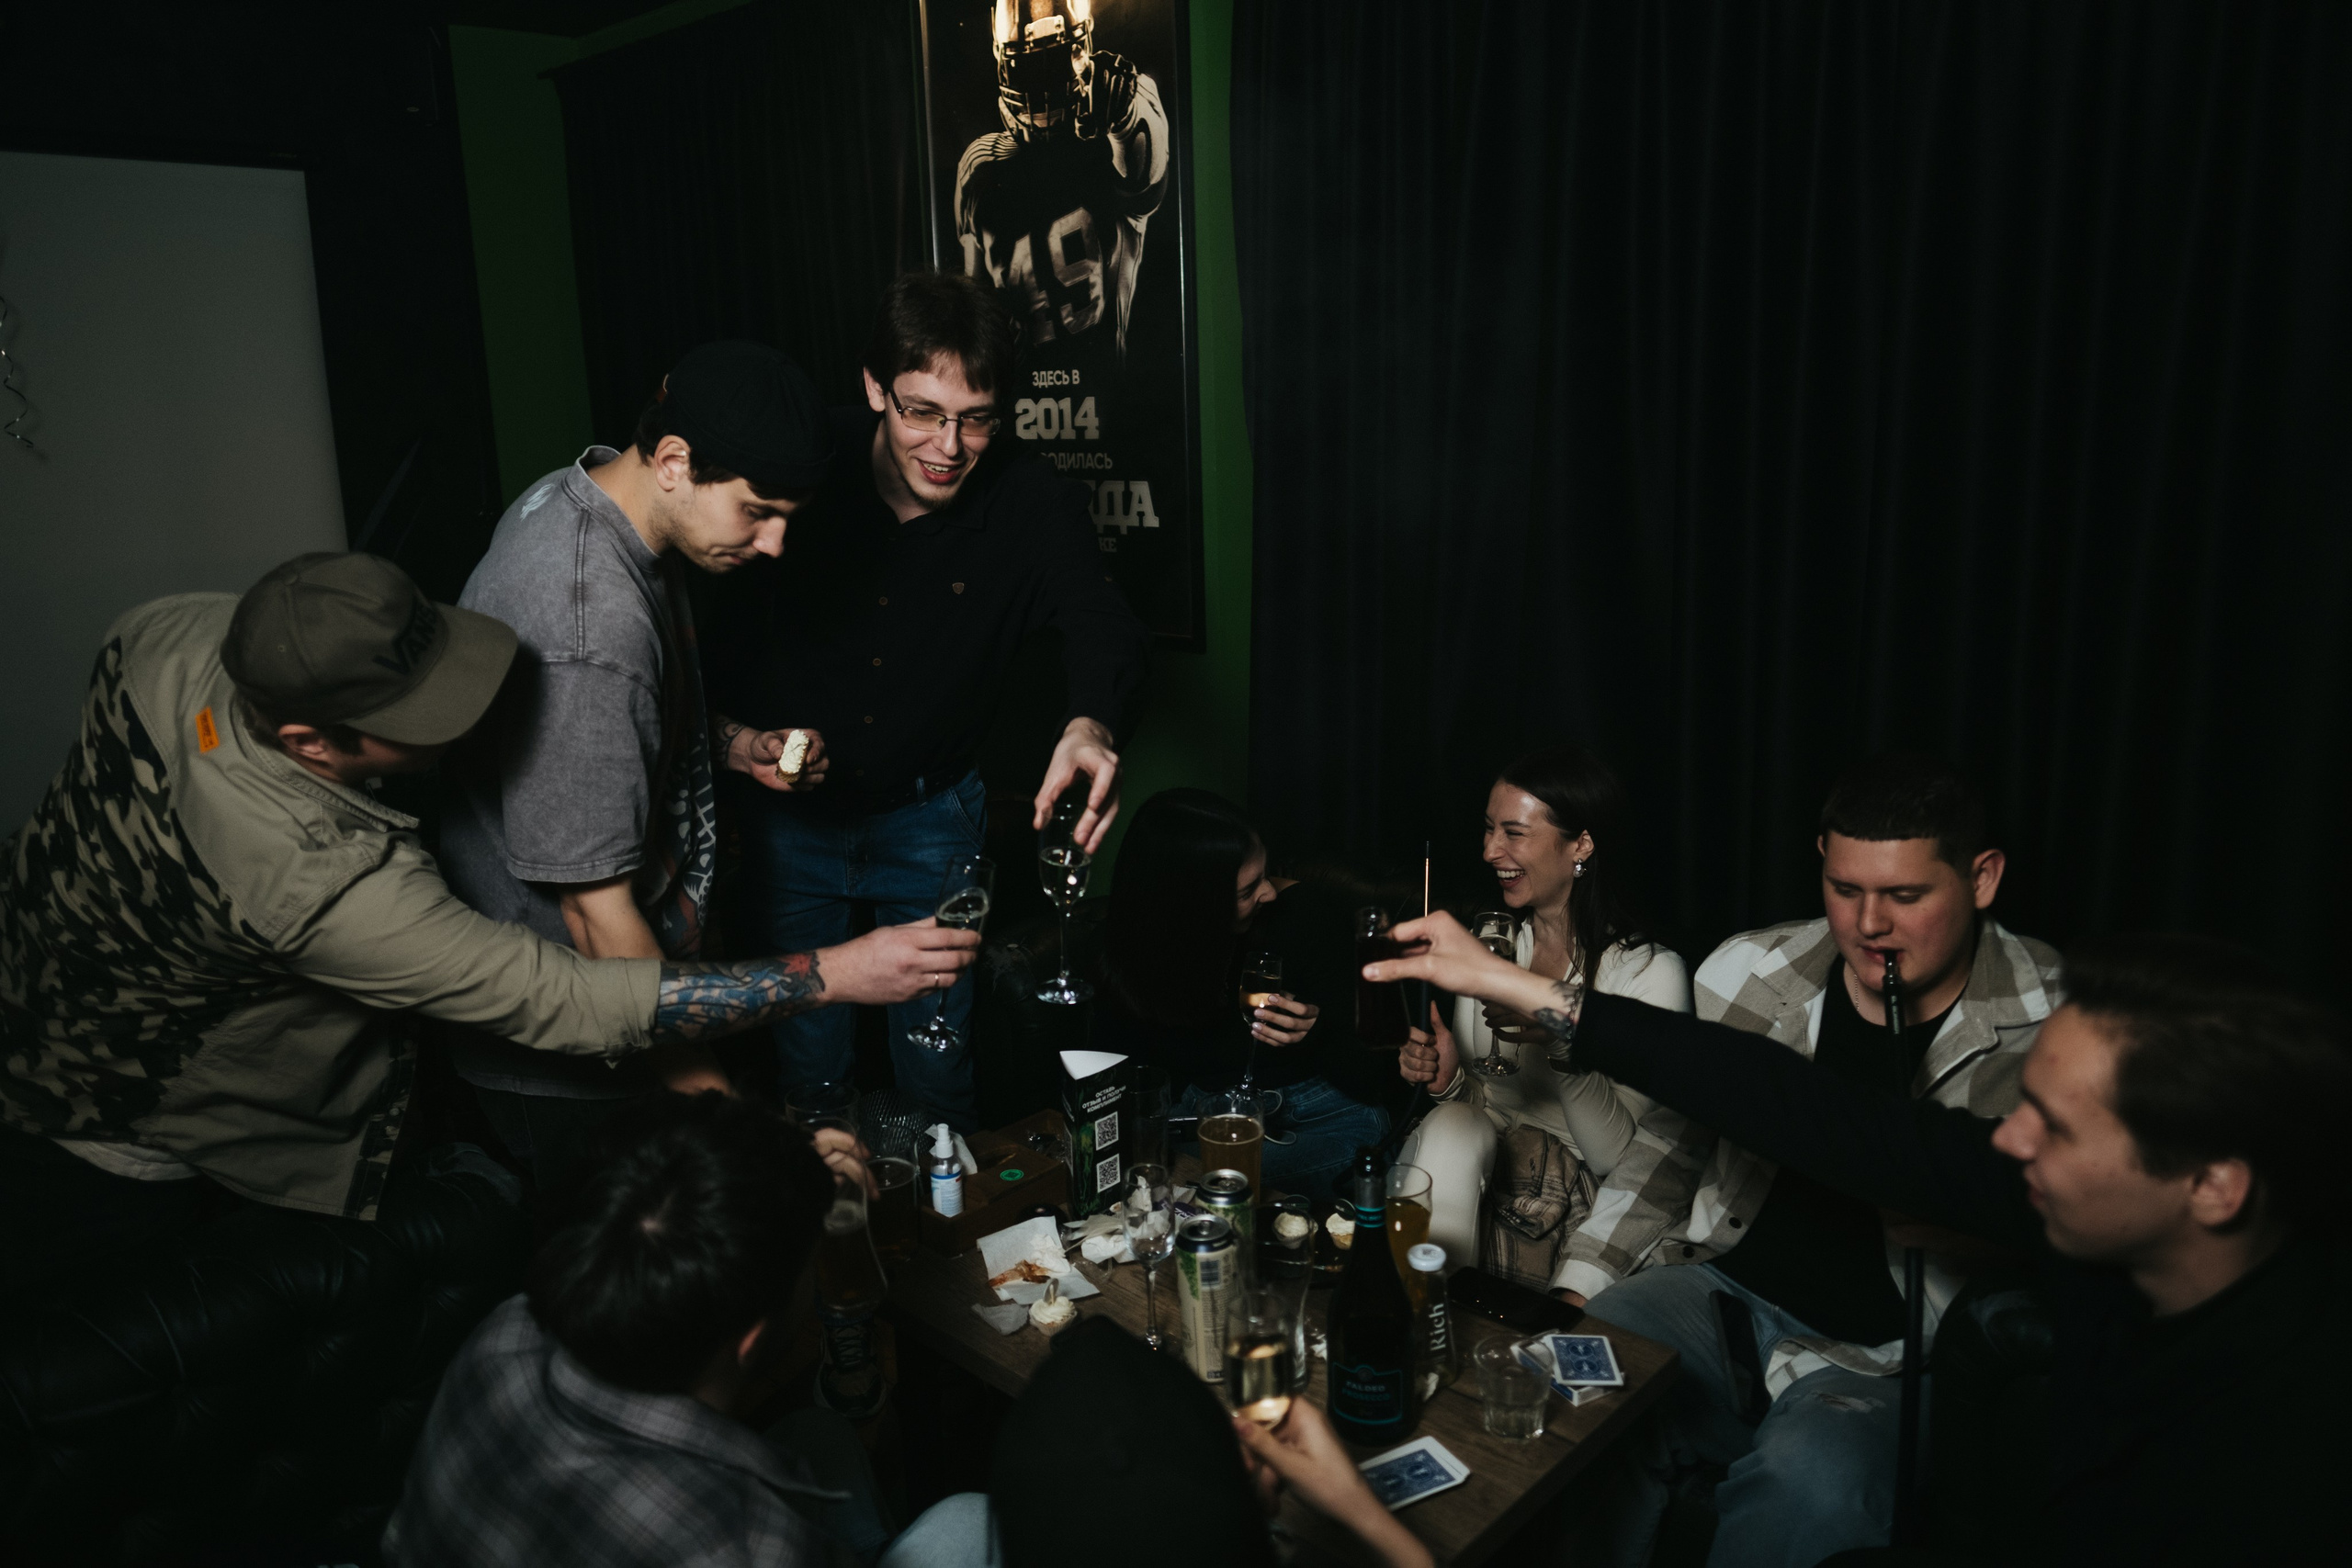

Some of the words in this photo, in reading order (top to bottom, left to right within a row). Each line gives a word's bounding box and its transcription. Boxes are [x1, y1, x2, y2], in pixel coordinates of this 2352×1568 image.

[1032, 369, 1069, 389] ЗДЕСЬ
[1071, 369, 1080, 386] В
[1014, 396, 1100, 440] 2014
[372, 594, 438, 676] VANS
[1081, 1098, 1102, 1110] ОТЗЫВ
[1427, 1303, 1447, 1351] Rich
